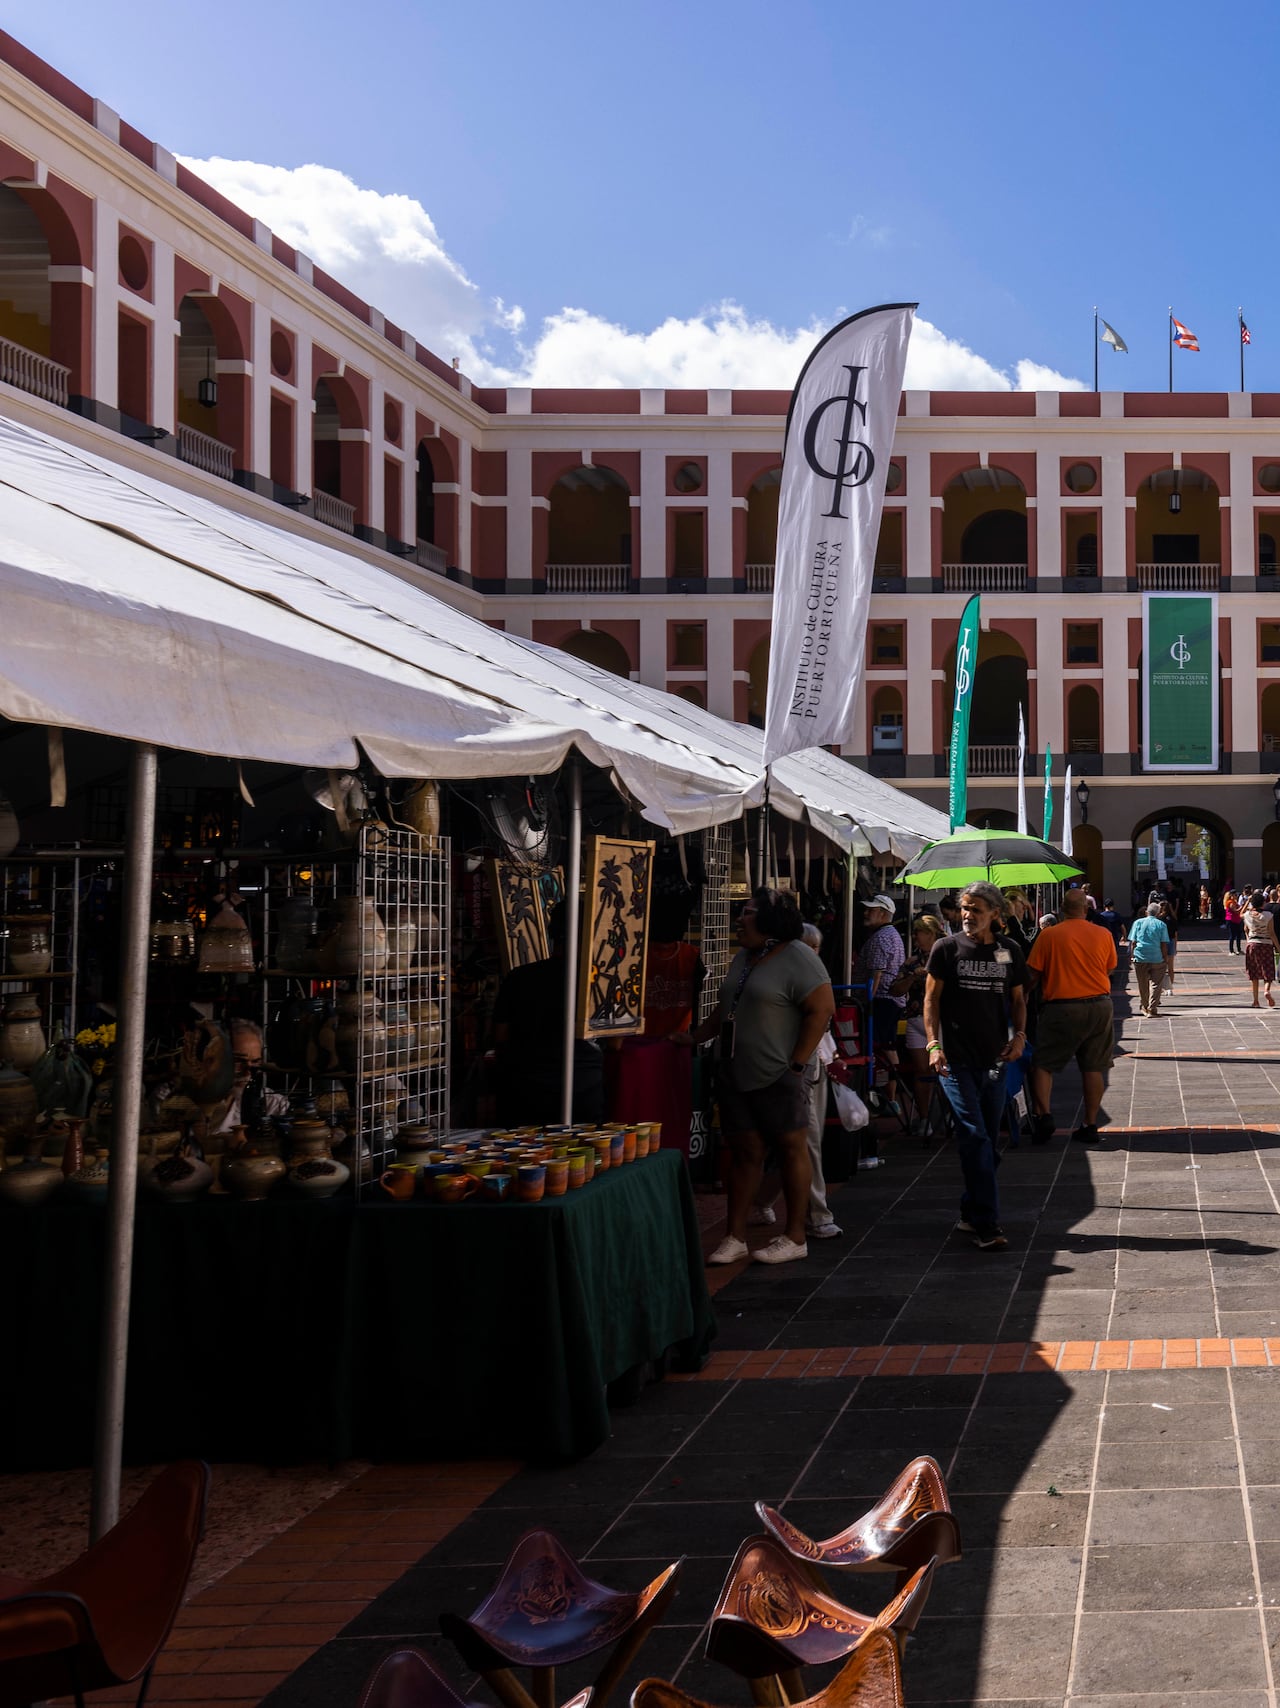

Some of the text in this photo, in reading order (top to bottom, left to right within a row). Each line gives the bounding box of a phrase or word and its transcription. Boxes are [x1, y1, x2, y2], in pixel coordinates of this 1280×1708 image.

[790, 540, 828, 717] INSTITUTO de CULTURA
[804, 542, 842, 719] PUERTORRIQUEÑA
